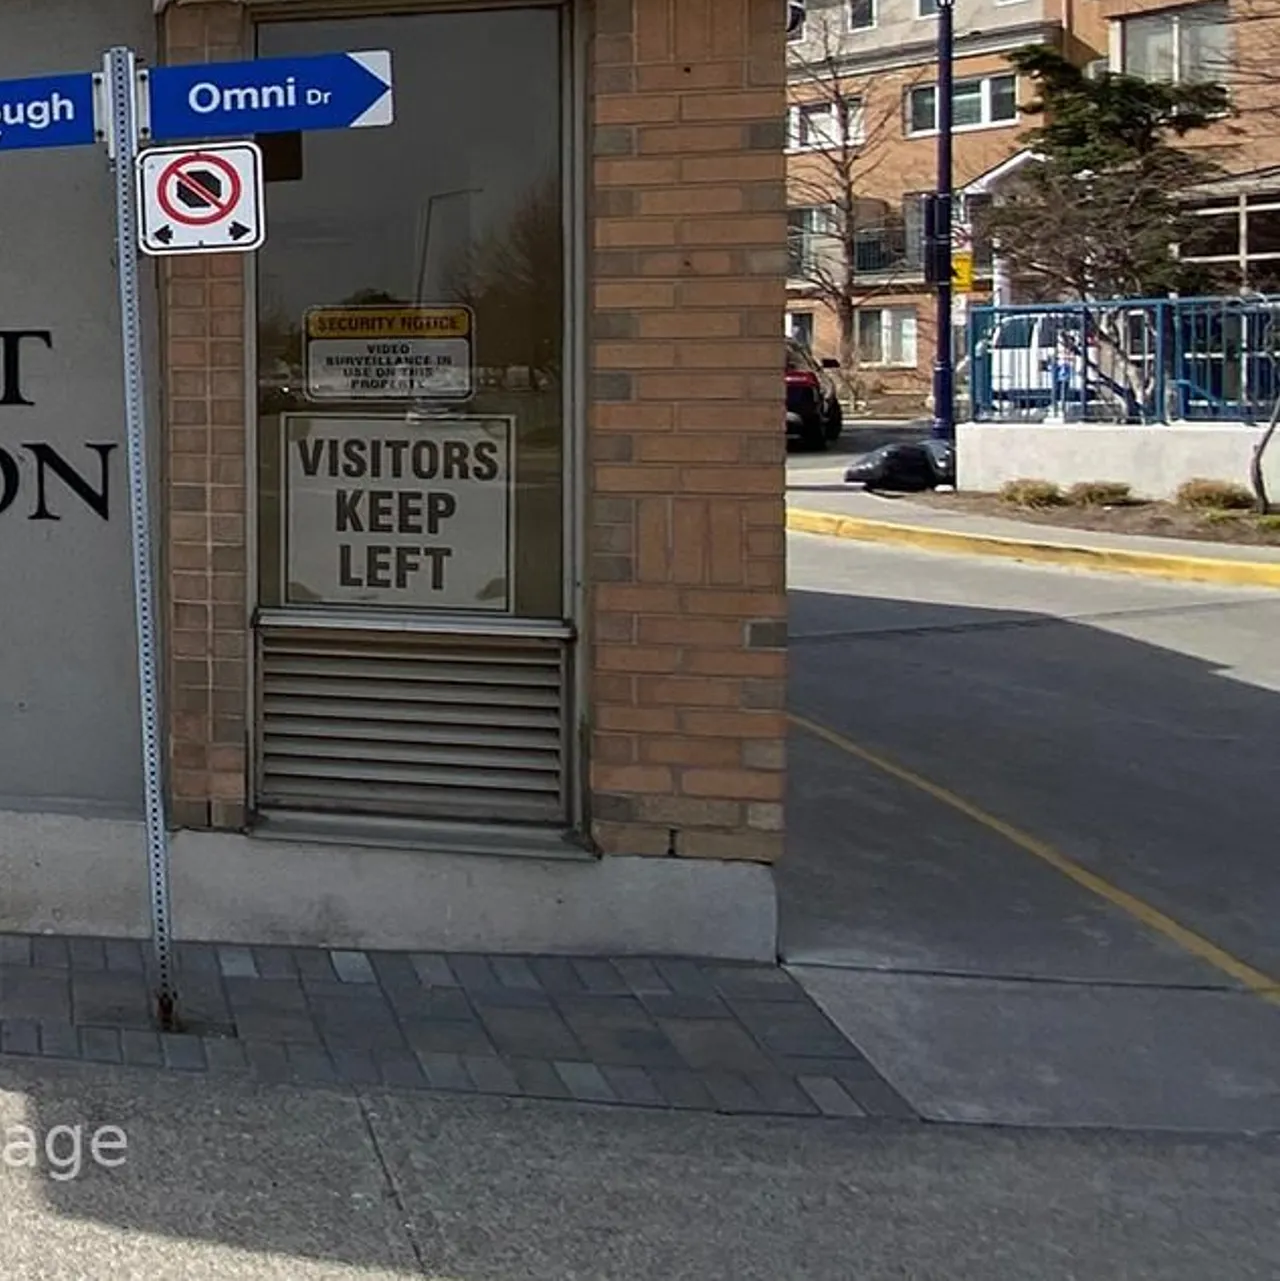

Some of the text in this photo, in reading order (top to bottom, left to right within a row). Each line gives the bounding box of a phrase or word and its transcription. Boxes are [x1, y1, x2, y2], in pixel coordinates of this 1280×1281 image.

[188, 77, 332, 115] Omni Dr
[318, 316, 461, 331] SECURITY NOTICE
[326, 355, 452, 367] SURVEILLANCE IN
[366, 343, 410, 355] VIDEO
[343, 366, 373, 378] USE
[376, 367, 396, 378] ON
[297, 439, 498, 481] VISITORS
[335, 489, 456, 535] KEEP
[339, 544, 452, 590] LEFT
